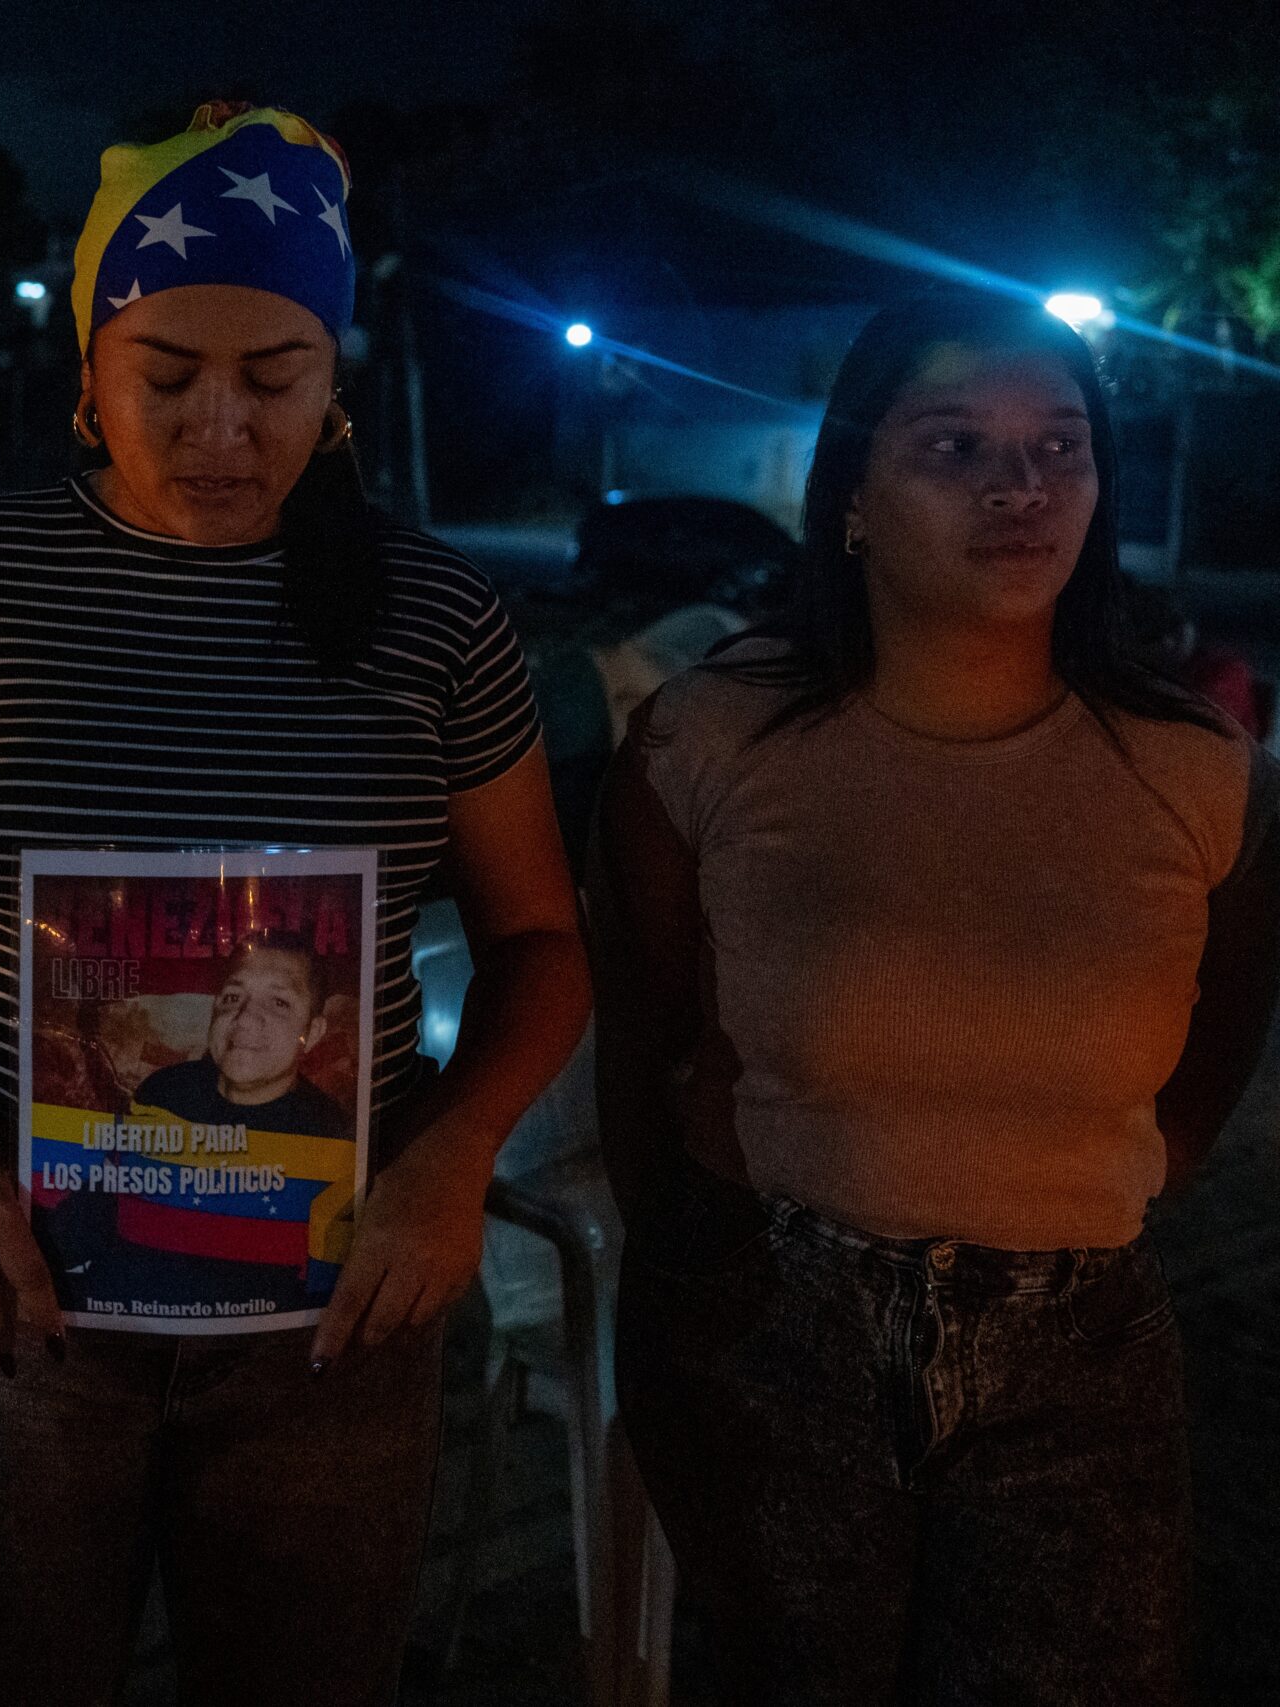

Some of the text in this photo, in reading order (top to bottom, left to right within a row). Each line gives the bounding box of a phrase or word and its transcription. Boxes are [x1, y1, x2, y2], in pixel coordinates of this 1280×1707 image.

[51, 957, 141, 1001] LIBRE
[83, 1121, 249, 1154] LIBERTAD PARA
[43, 1161, 287, 1196] LOS PRESOS POLÍTICOS
[86, 1297, 276, 1317] Insp. Reinardo Morillo
